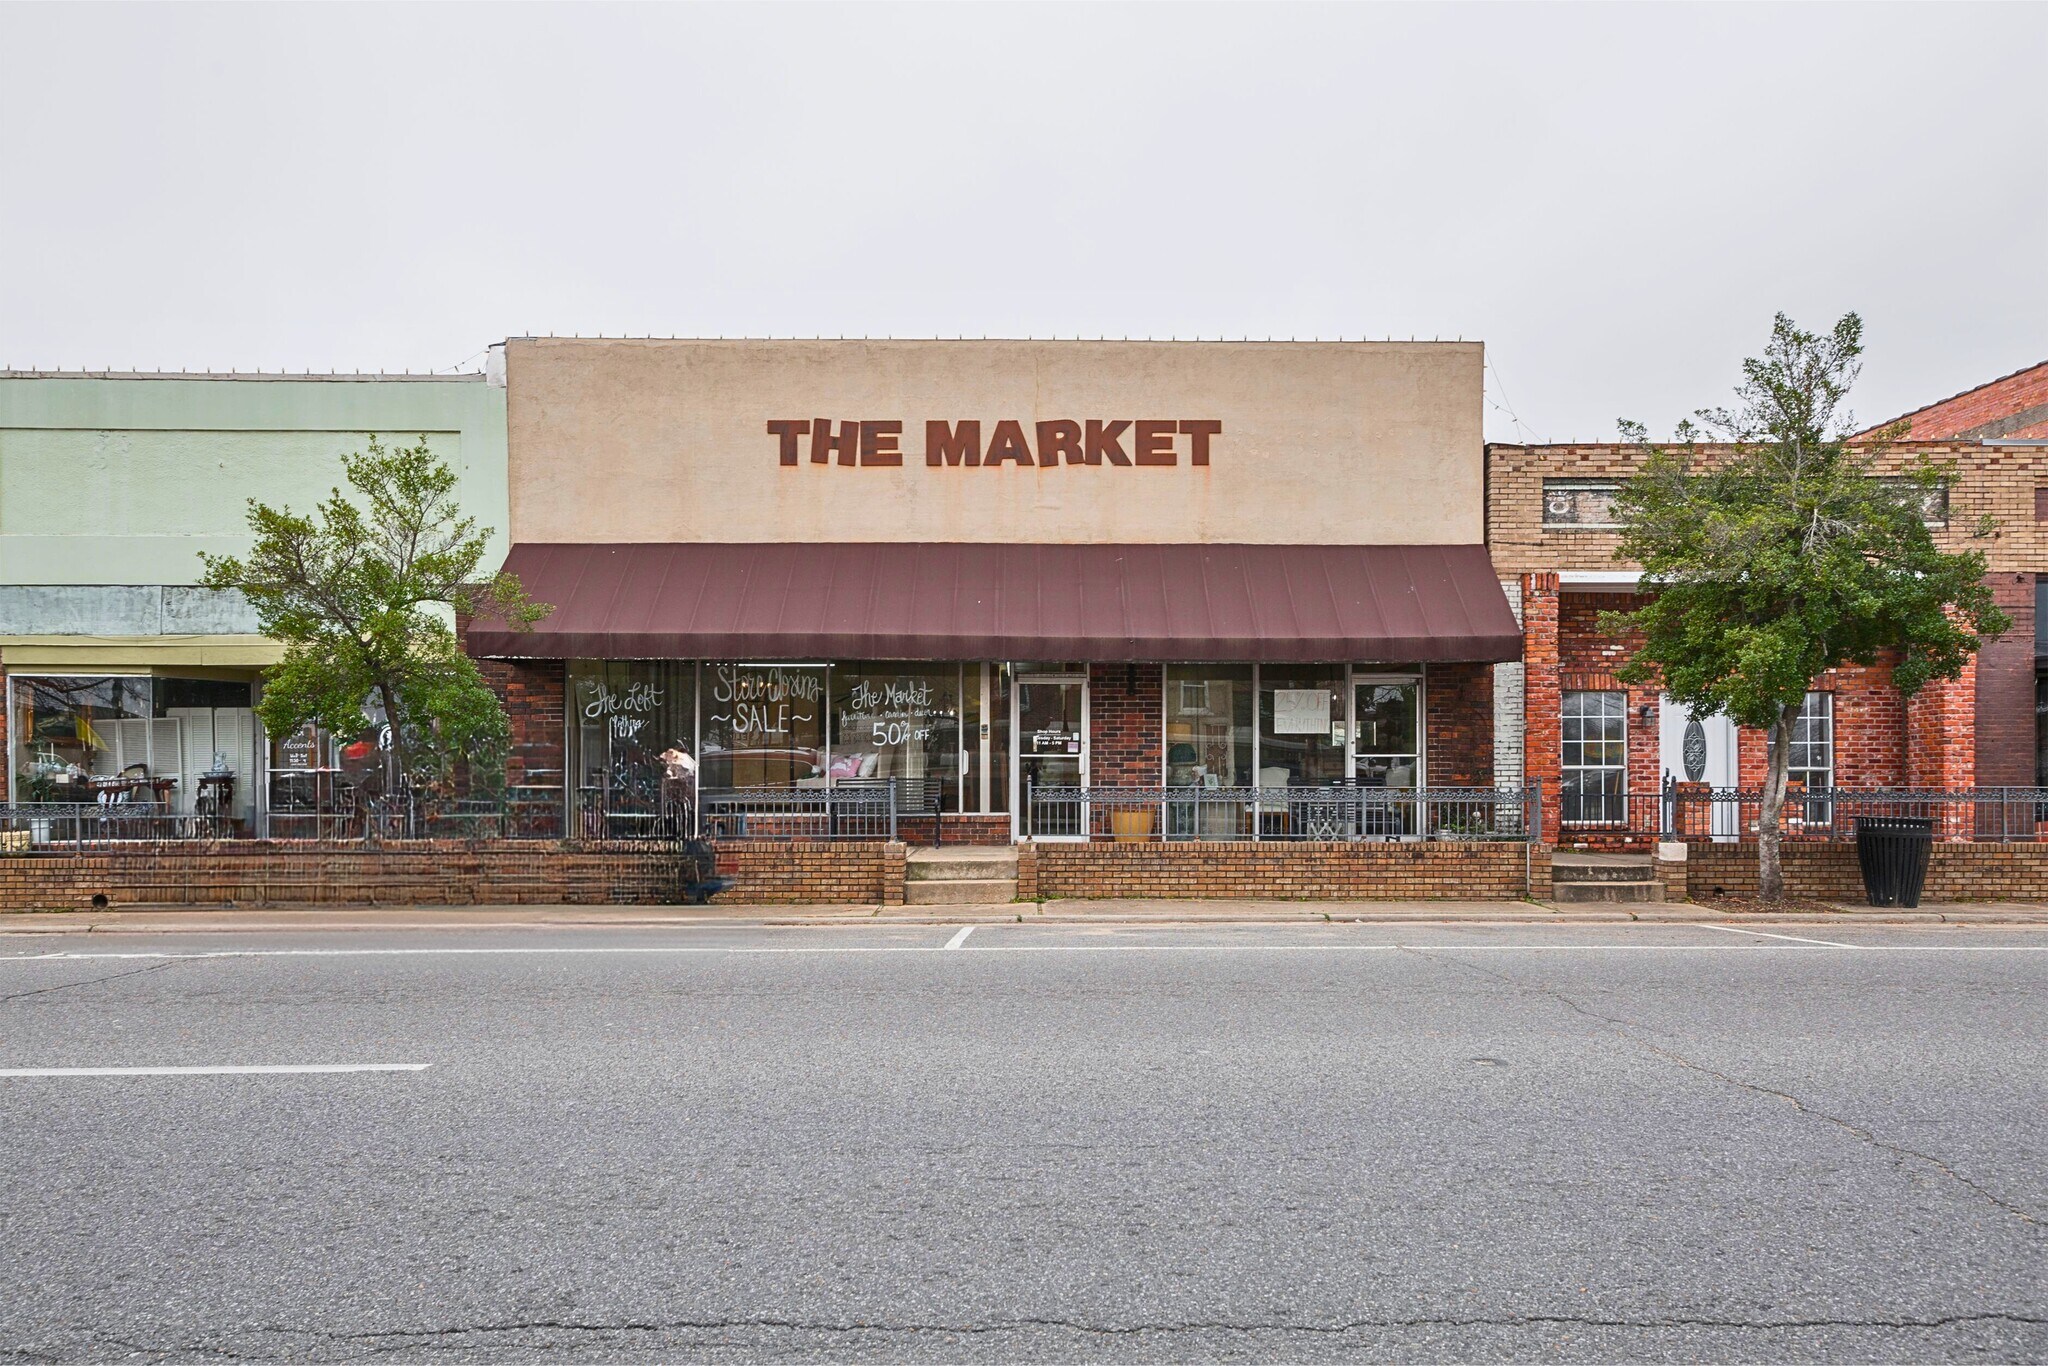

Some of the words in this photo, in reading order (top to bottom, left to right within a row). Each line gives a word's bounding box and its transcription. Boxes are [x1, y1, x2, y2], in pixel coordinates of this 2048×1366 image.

[767, 418, 903, 467] THE
[926, 419, 1222, 467] MARKET
[585, 682, 622, 718] The
[624, 681, 665, 712] Loft
[713, 666, 767, 702] Store
[767, 667, 824, 703] Closing
[851, 680, 883, 710] The
[884, 680, 934, 709] Market
[872, 720, 912, 746] 50%
[914, 729, 930, 740] OFF
